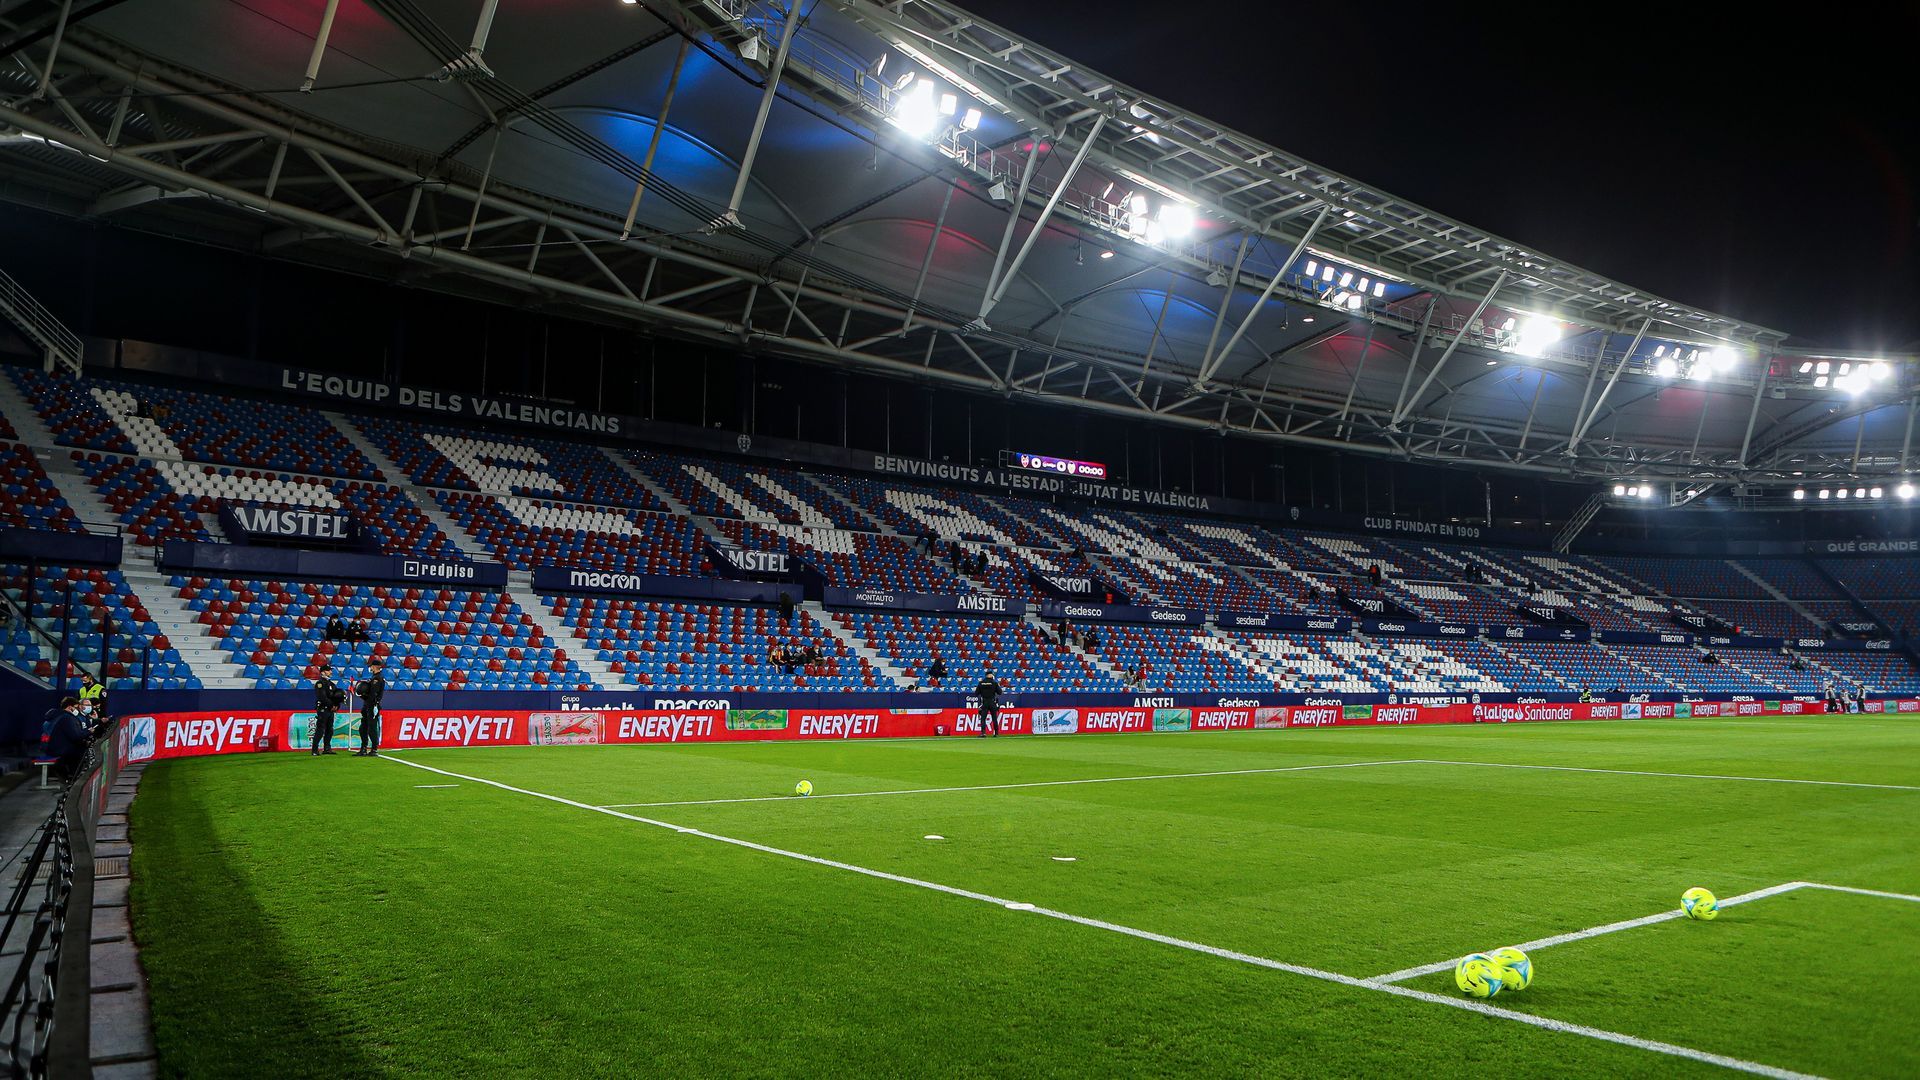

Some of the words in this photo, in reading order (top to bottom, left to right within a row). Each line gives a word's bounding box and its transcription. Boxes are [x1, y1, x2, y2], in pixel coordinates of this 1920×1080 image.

[399, 387, 463, 413] DELS
[472, 397, 620, 434] VALENCIANS
[1031, 458, 1042, 469] 0
[1057, 461, 1067, 472] 0
[1079, 465, 1104, 476] 00:00
[874, 455, 979, 483] BENVINGUTS
[983, 472, 995, 485] A
[1123, 489, 1140, 503] DE
[1143, 489, 1210, 511] VALÈNCIA
[233, 506, 348, 539] AMSTEL
[1364, 517, 1392, 530] CLUB
[1395, 520, 1438, 534] FUNDAT
[1440, 523, 1454, 536] EN
[1457, 525, 1480, 538] 1909
[1827, 540, 1856, 552] QUÉ
[1858, 541, 1918, 552] GRANDE
[422, 563, 474, 580] redpiso
[570, 570, 641, 590] macron
[855, 593, 894, 603] MONTAUTO
[957, 596, 1006, 612] AMSTEL
[1064, 605, 1102, 617] Gedesco
[1151, 610, 1186, 621] Gedesco
[1236, 616, 1266, 626] sesderma
[1307, 619, 1334, 629] sesderma
[1378, 623, 1405, 632] Gedesco
[1440, 625, 1466, 635] Gedesco
[1660, 634, 1685, 644] macron
[1798, 639, 1819, 647] asisa
[654, 699, 731, 710] macron
[965, 695, 979, 703] Grupo
[1218, 698, 1260, 708] Gedesco
[1304, 697, 1342, 707] Gedesco
[1376, 708, 1418, 724] ENERYETI
[1484, 705, 1515, 723] LaLiga
[1524, 705, 1573, 720] Santander
[1590, 705, 1619, 719] ENERYETI
[1644, 705, 1672, 718] ENERYETI
[1694, 704, 1718, 716] ENERYETI
[1086, 712, 1146, 732] ENERYETI
[1197, 710, 1249, 730] ENERYETI
[1292, 709, 1337, 727] ENERYETI
[399, 715, 514, 750] ENERYETI
[617, 714, 713, 742] ENERYETI
[800, 713, 879, 739] ENERYETI
[164, 717, 271, 751] ENERYETI
